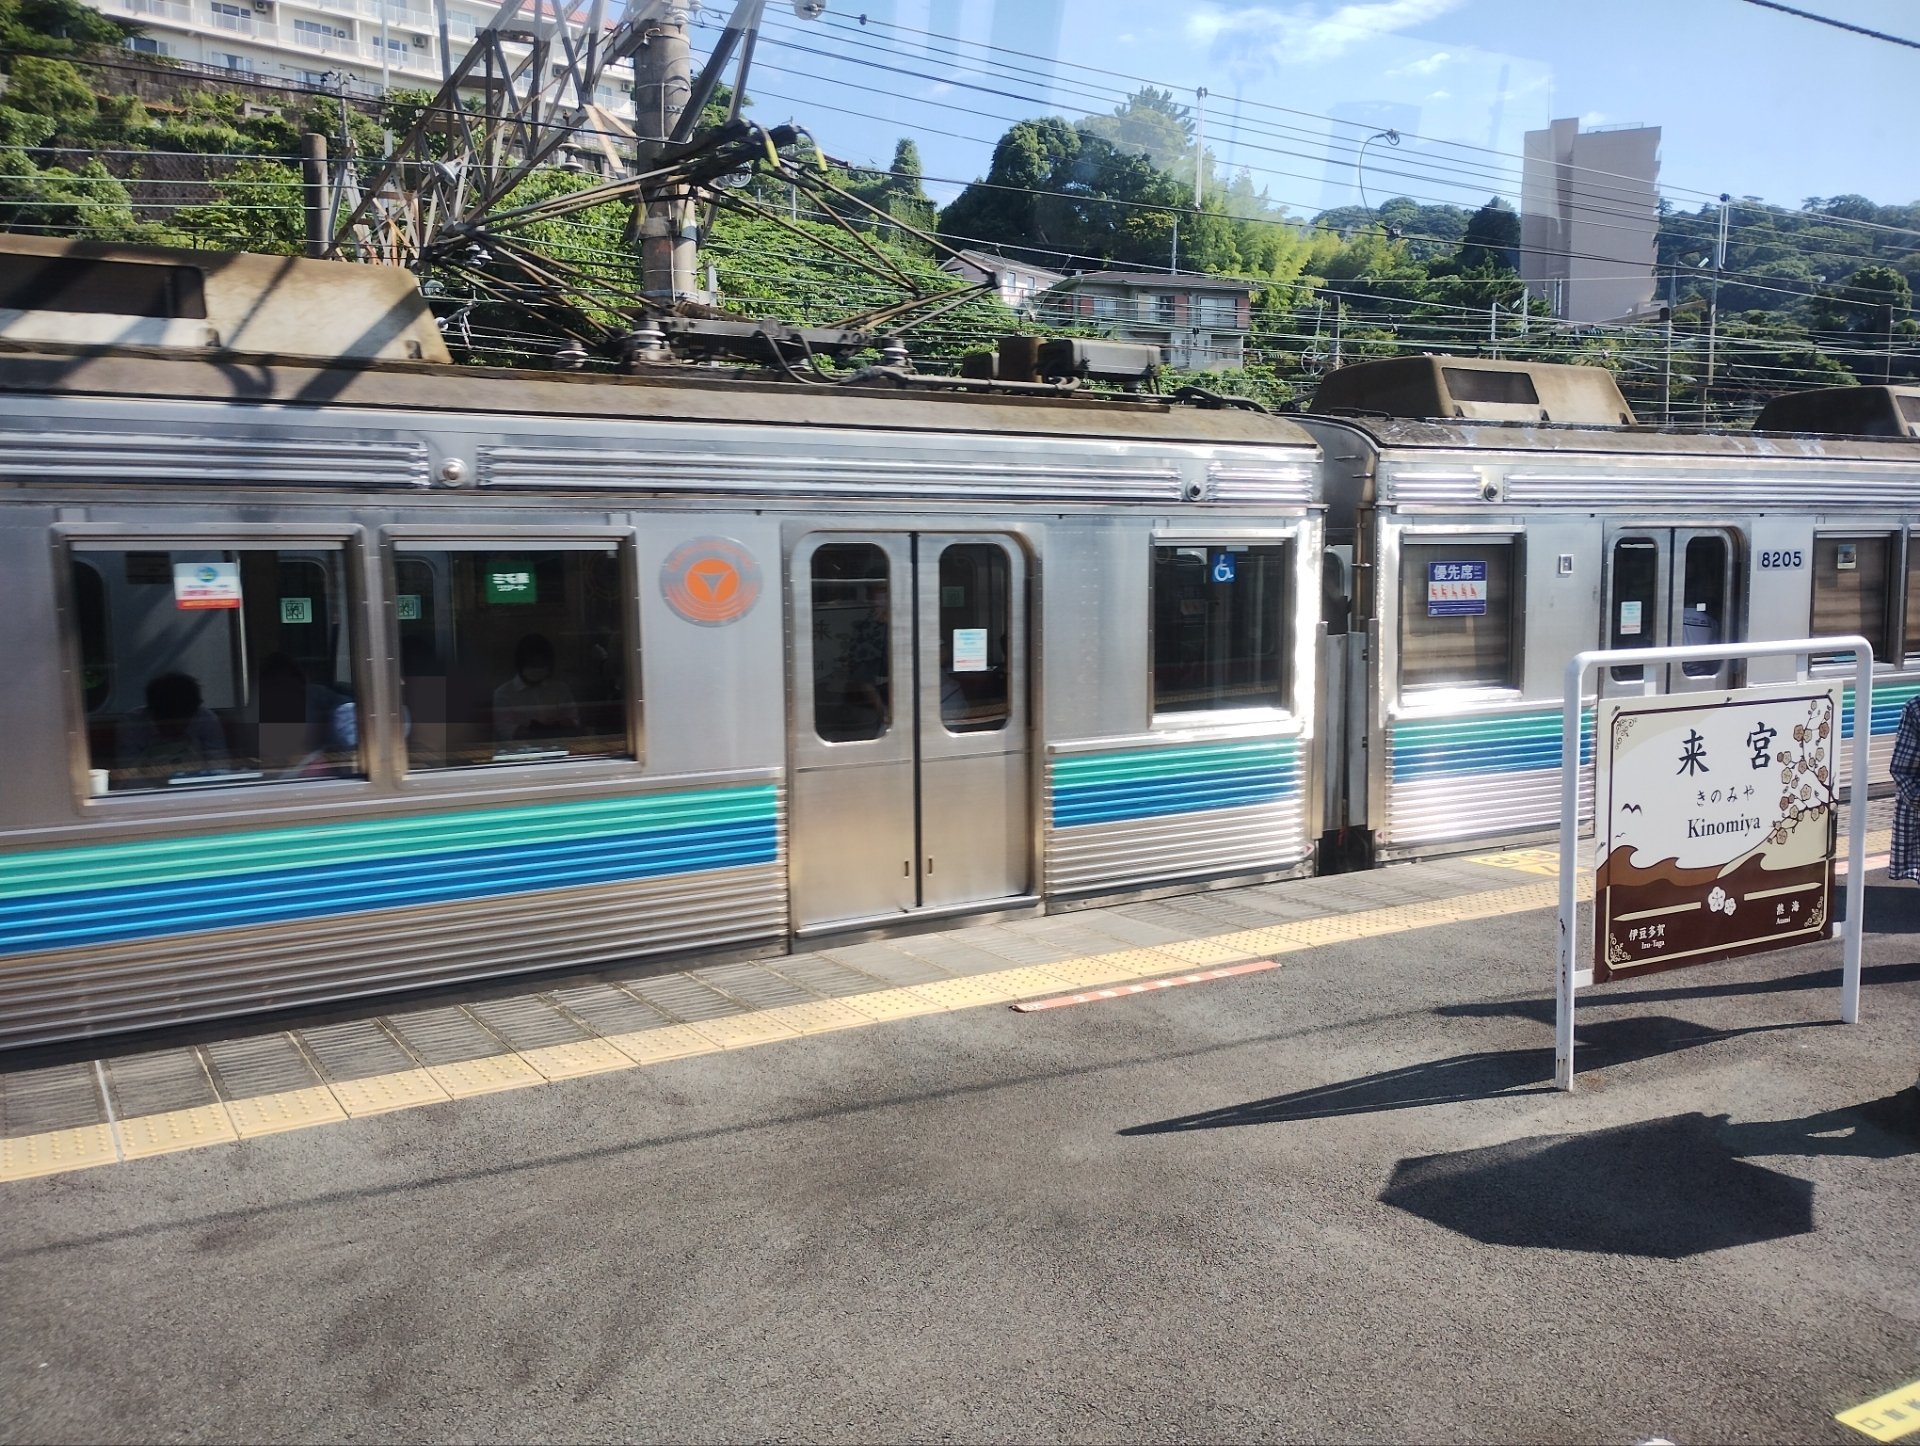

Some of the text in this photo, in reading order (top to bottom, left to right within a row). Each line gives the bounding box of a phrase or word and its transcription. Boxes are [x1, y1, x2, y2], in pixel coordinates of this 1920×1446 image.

[1761, 551, 1802, 568] 8205
[1434, 564, 1473, 580] 優先席
[1676, 721, 1777, 777] 来宮
[1696, 784, 1755, 807] きのみや
[1687, 813, 1761, 838] Kinomiya
[1628, 923, 1666, 941] 伊豆多賀
